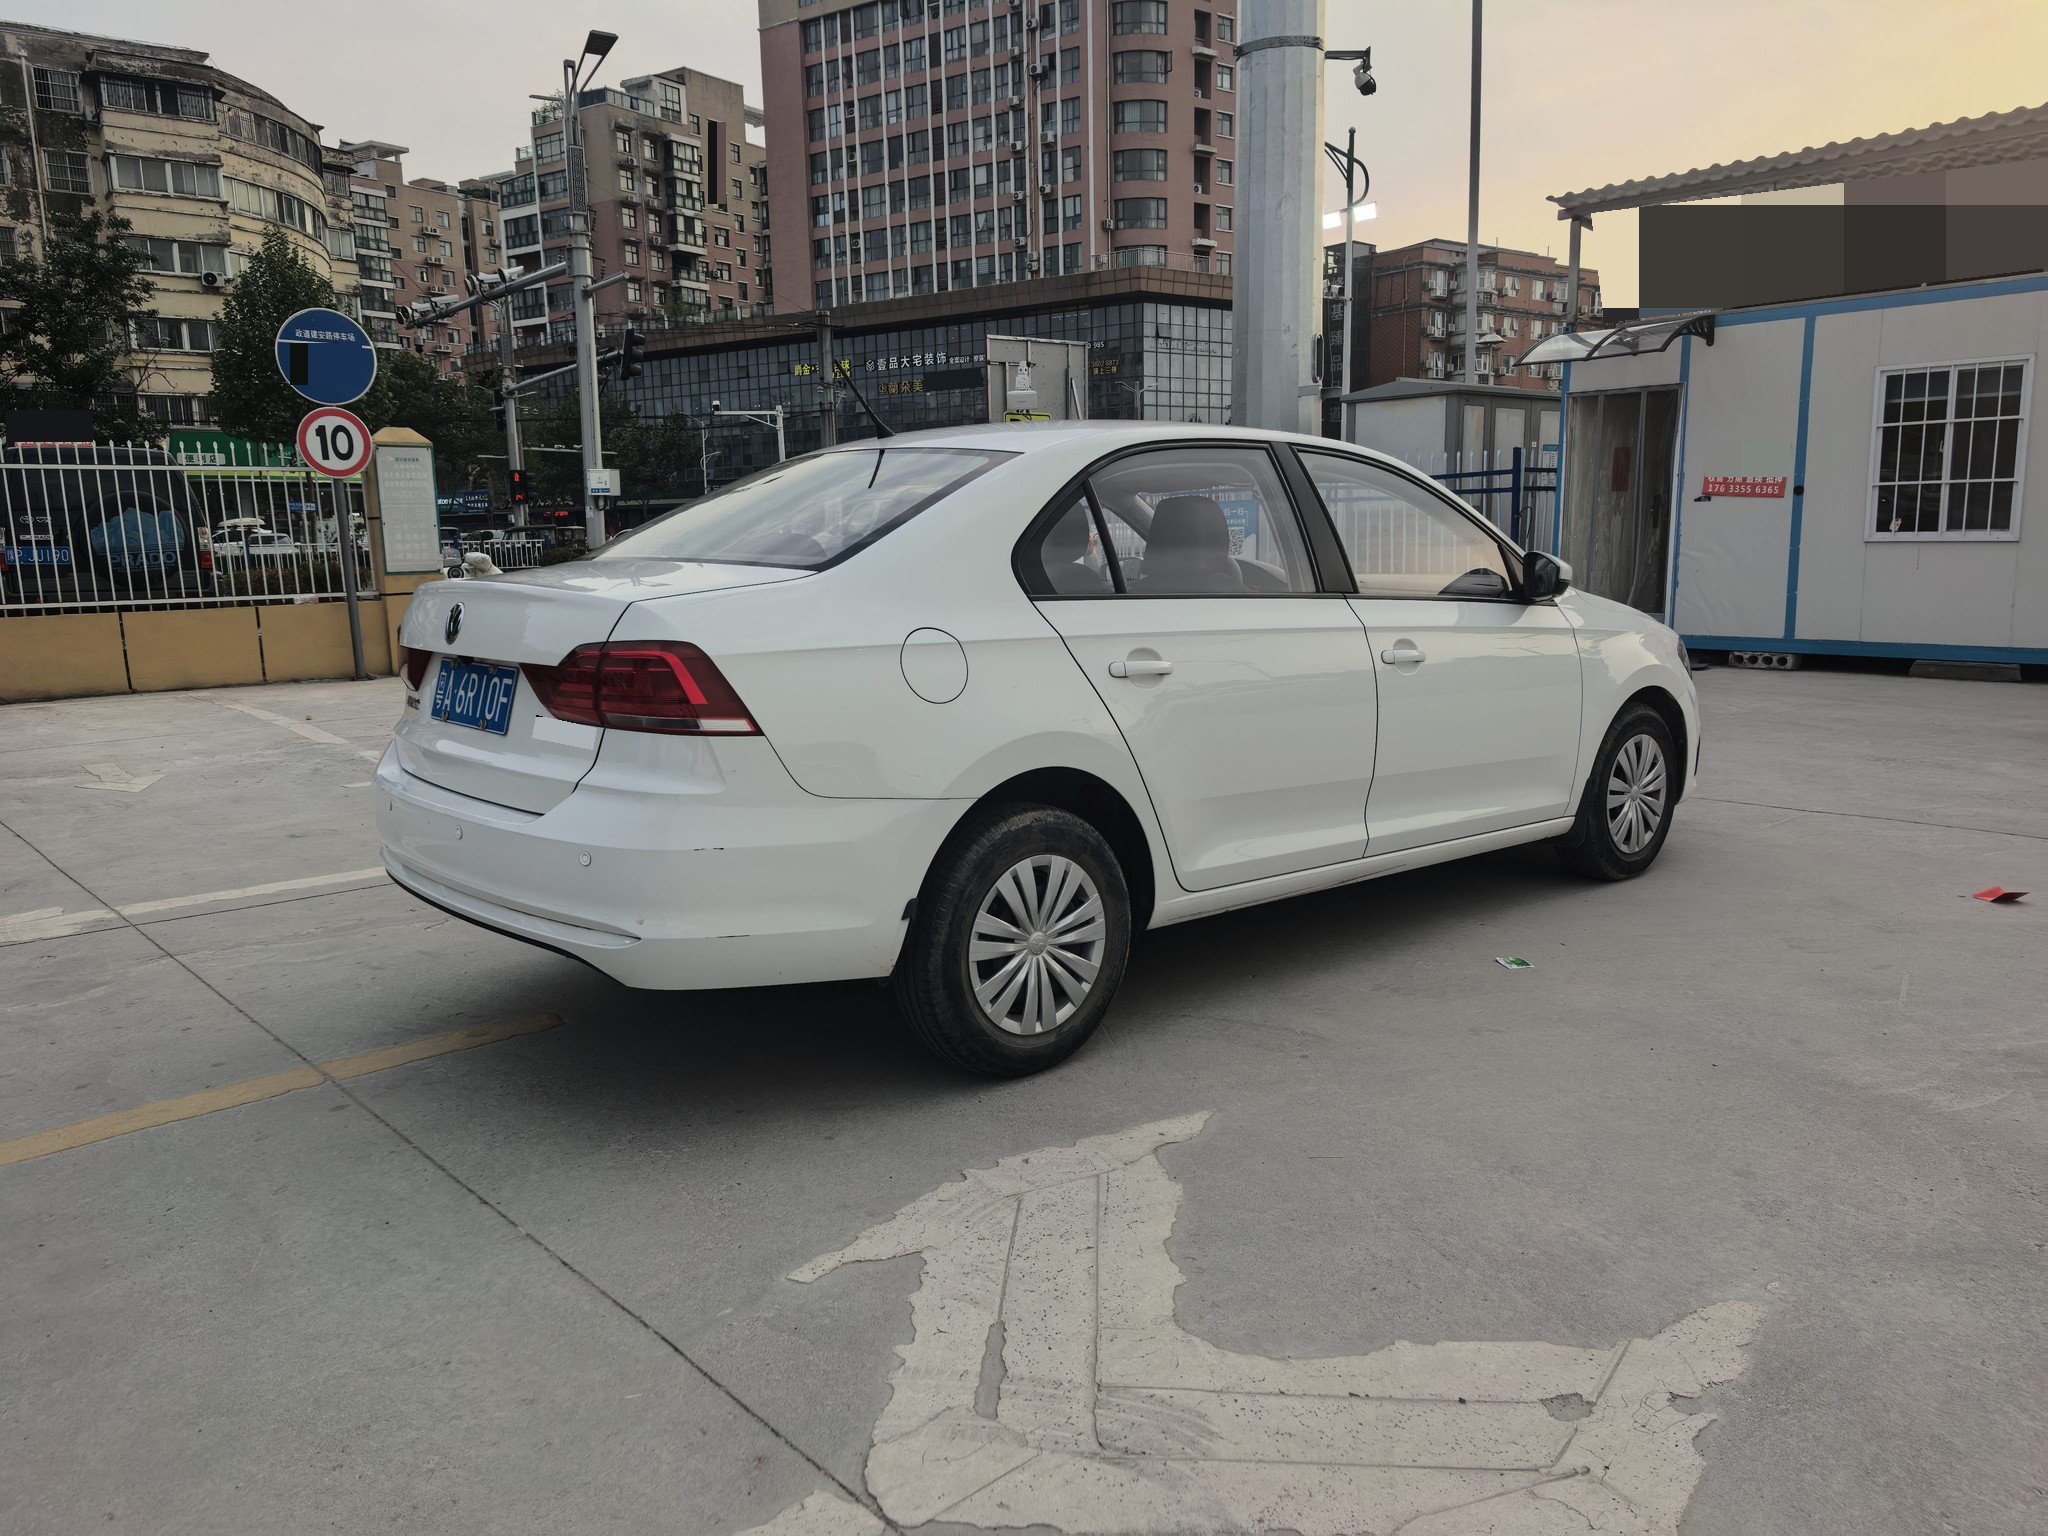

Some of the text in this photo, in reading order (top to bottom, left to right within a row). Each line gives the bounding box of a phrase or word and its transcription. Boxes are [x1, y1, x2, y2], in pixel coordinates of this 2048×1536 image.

[876, 352, 947, 371] 壹品大宅装饰
[315, 425, 354, 461] 10
[185, 454, 217, 463] 便利店
[1707, 484, 1779, 494] 176 3355 6365
[435, 669, 513, 722] 粤A·6R10F
